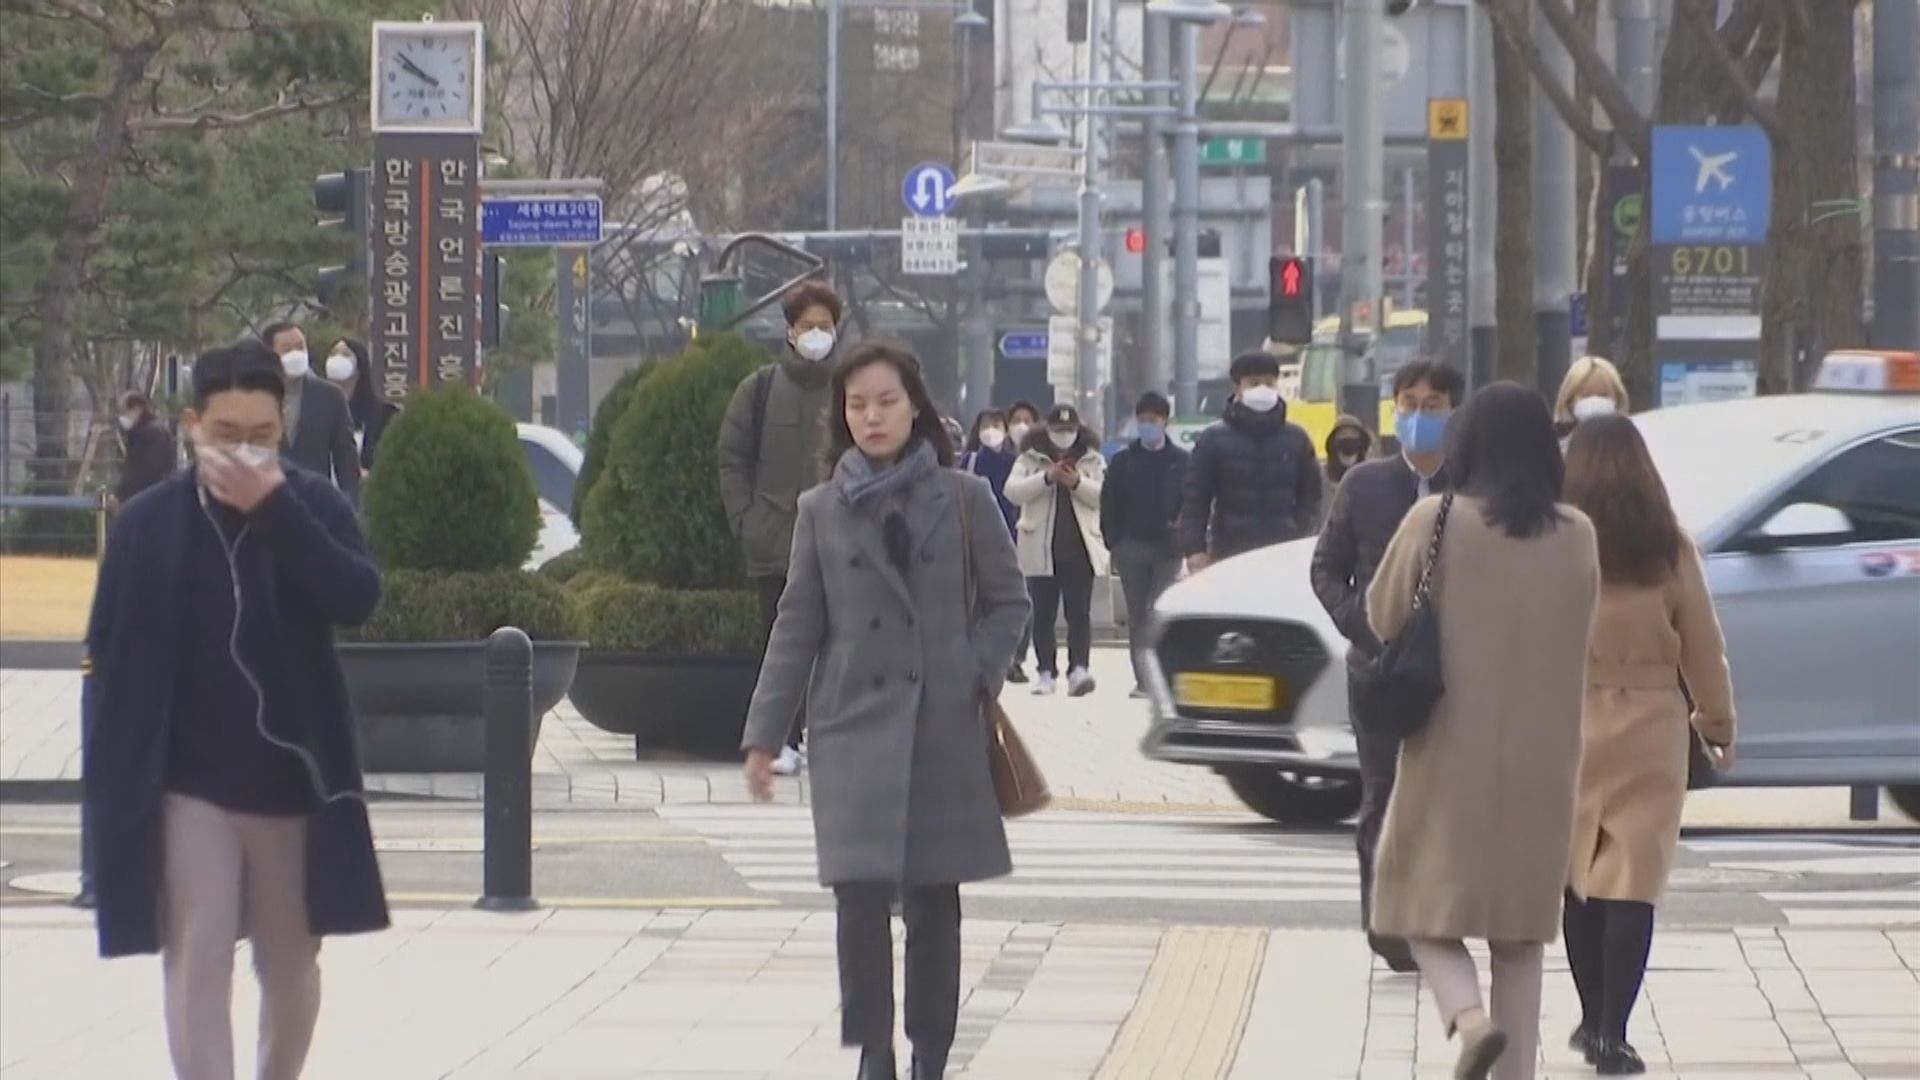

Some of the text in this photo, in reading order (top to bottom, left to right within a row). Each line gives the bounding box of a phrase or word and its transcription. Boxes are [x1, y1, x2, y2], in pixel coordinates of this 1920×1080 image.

[516, 201, 598, 218] 세종대로20길
[1682, 205, 1748, 223] 공항버스
[438, 158, 466, 381] 한국언론진흥
[571, 255, 586, 278] 4
[1671, 247, 1749, 274] 6701
[383, 158, 411, 411] 한국방송광고진흥
